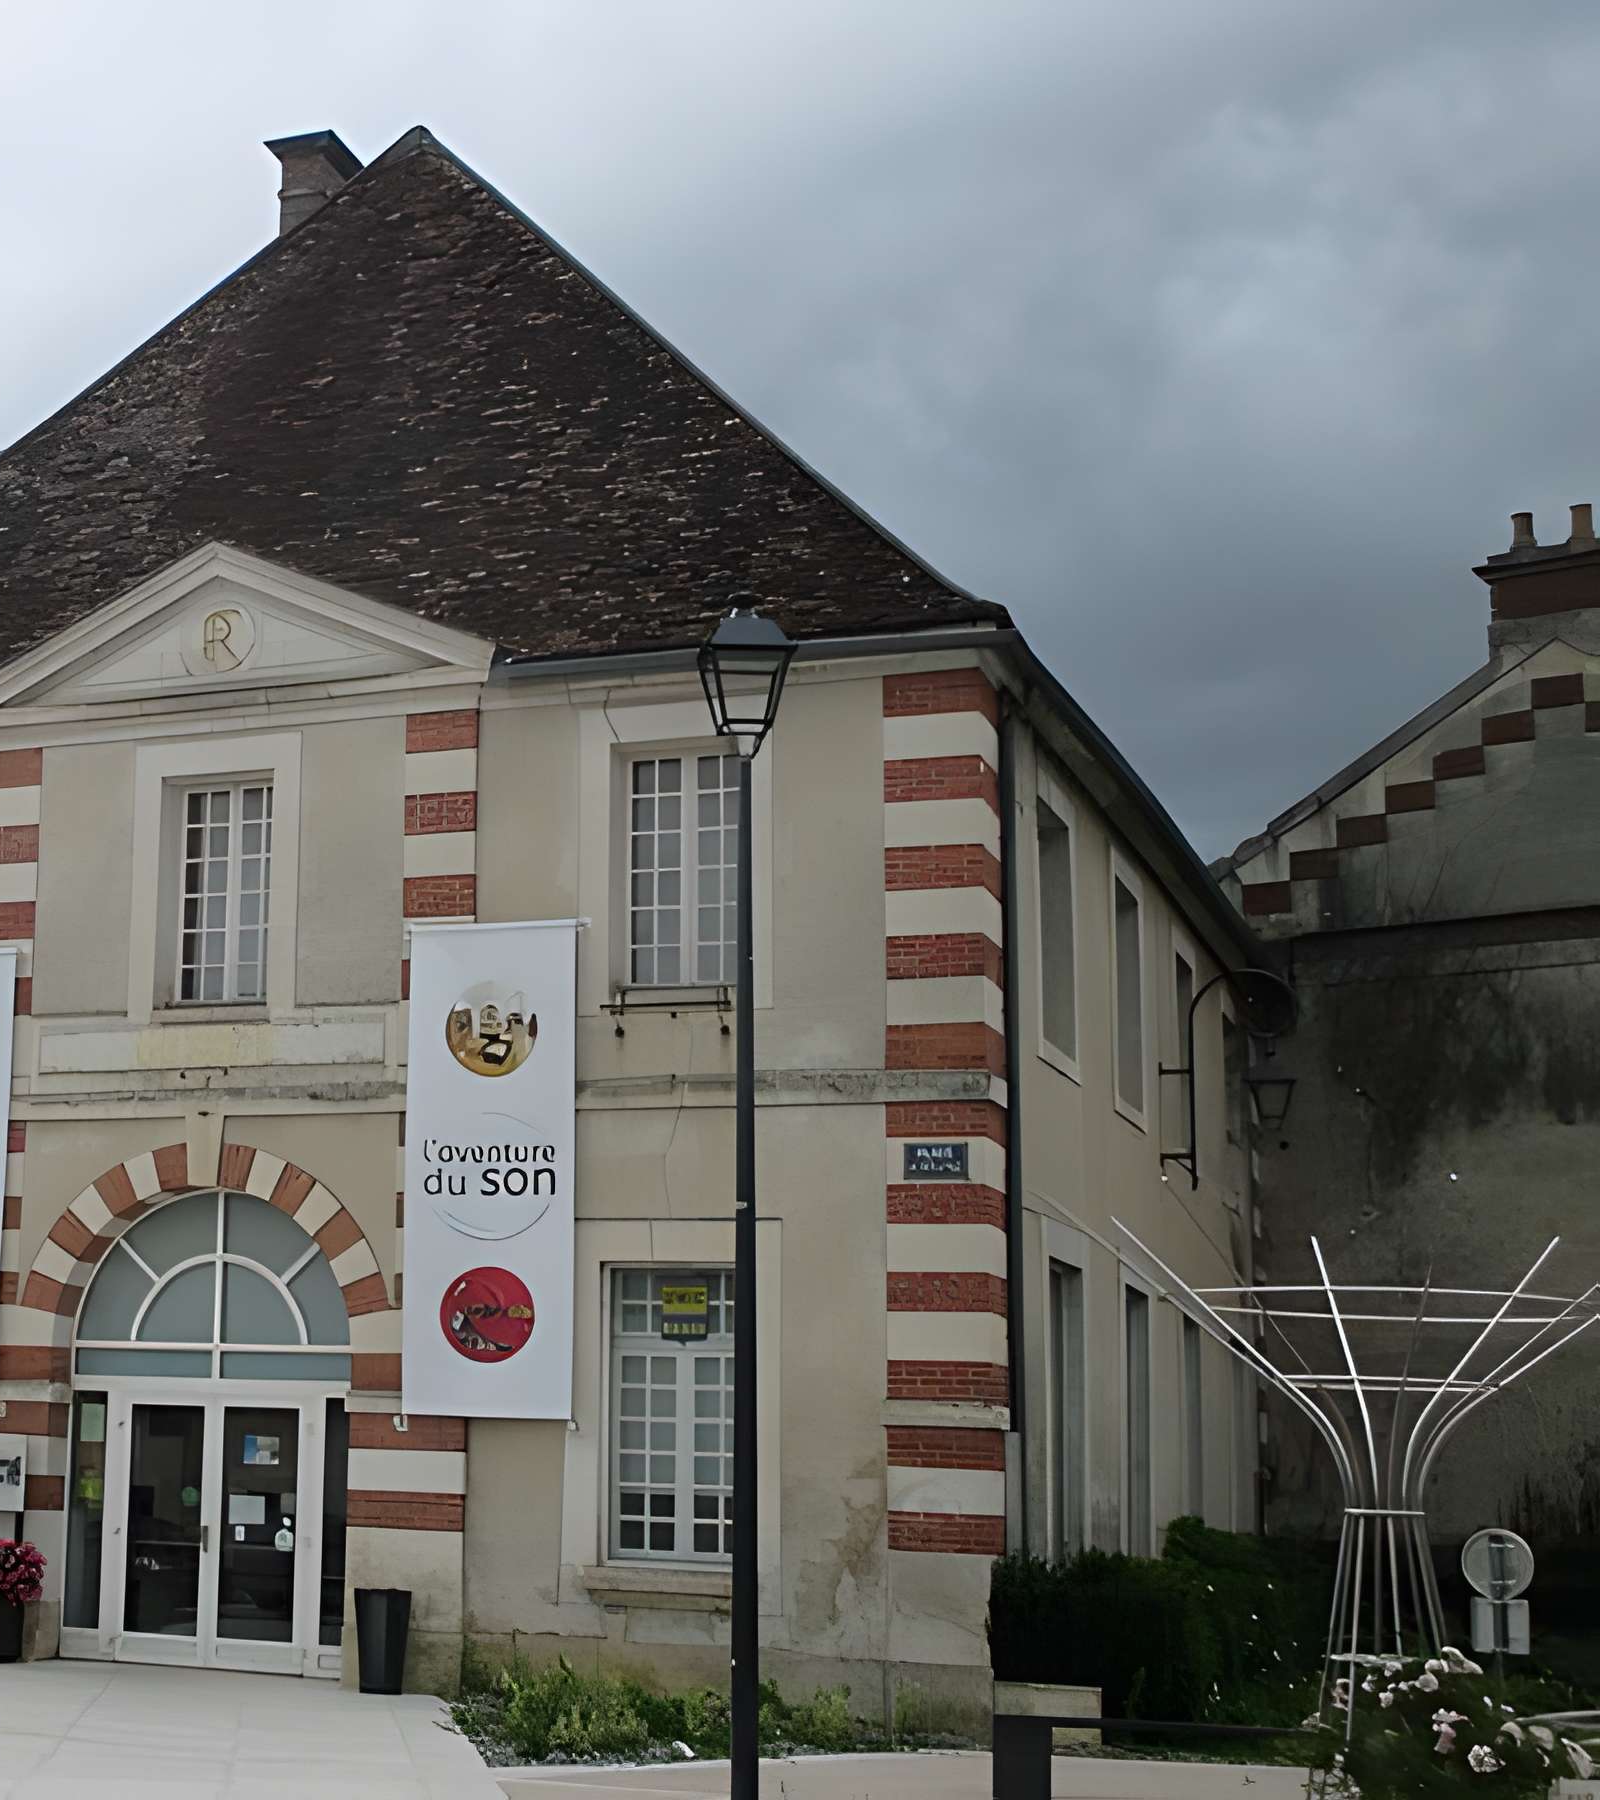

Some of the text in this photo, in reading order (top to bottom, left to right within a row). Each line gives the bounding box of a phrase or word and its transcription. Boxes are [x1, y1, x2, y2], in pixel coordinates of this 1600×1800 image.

[424, 1139, 555, 1163] l'aventure
[423, 1167, 556, 1197] du son
